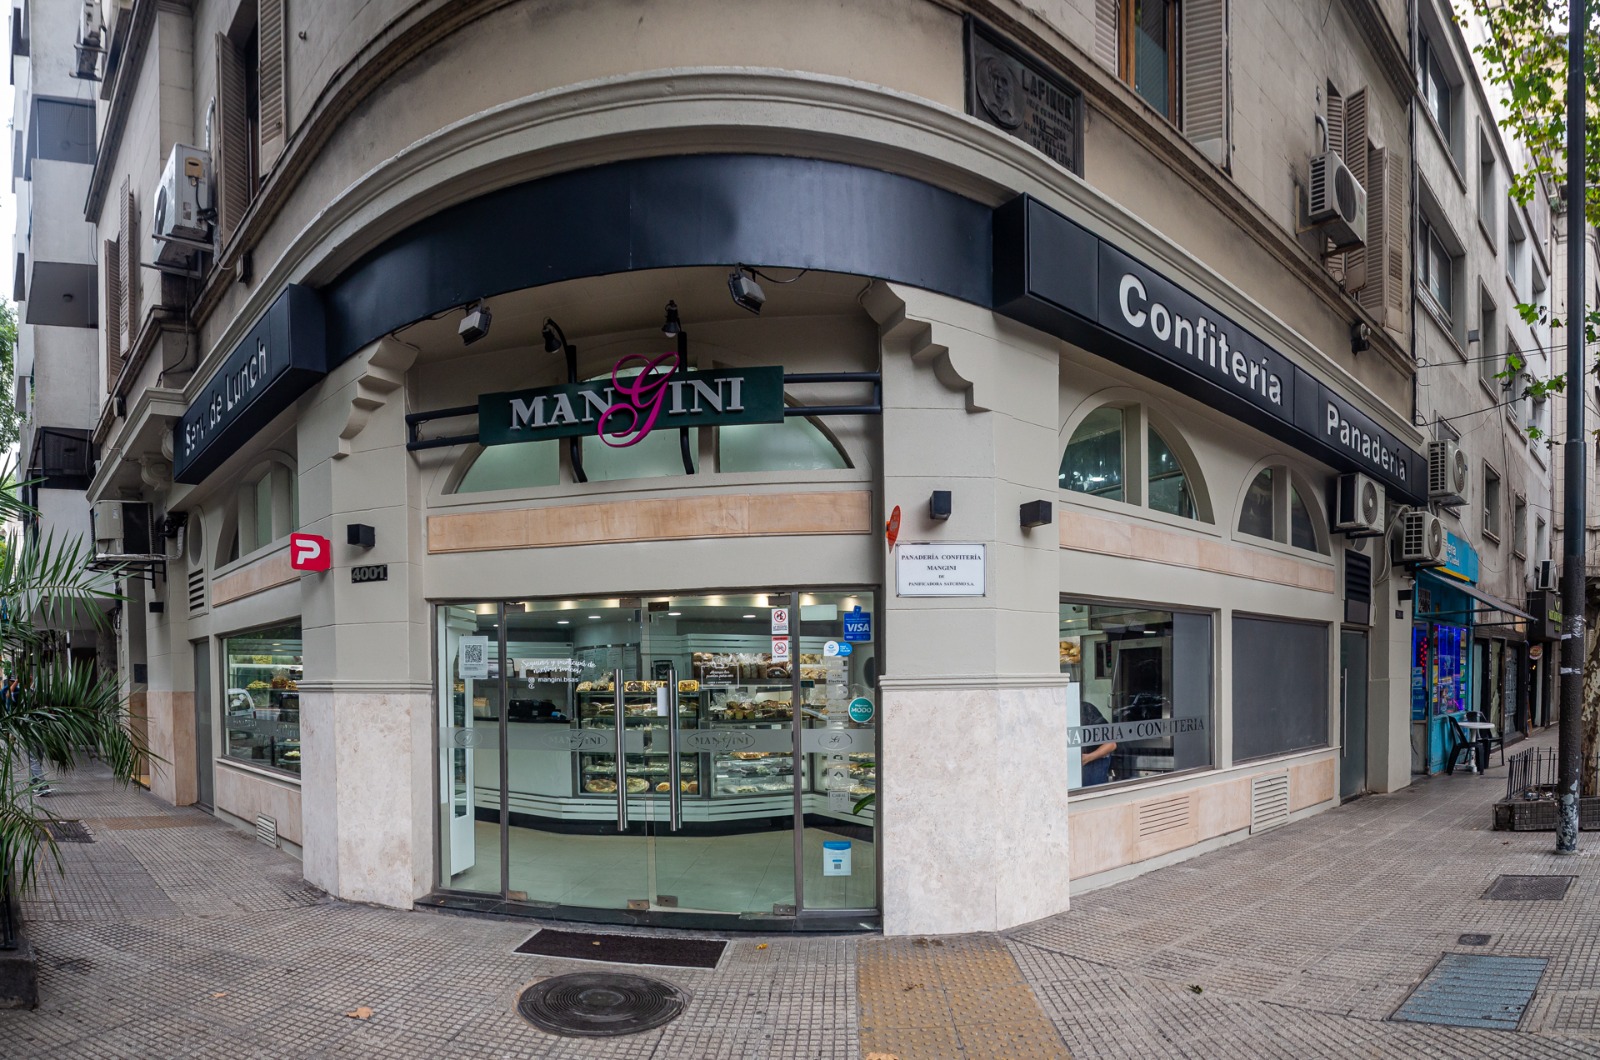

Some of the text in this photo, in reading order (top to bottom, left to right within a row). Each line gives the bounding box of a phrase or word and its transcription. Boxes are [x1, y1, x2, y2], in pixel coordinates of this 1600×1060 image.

[1119, 273, 1283, 406] Confitería
[186, 337, 267, 457] Serv. de Lunch
[509, 351, 745, 448] MANGINI
[1327, 401, 1407, 482] Panadería
[295, 539, 320, 565] P
[901, 553, 982, 561] PANADERÍA CONFITERÍA
[352, 566, 384, 581] 4001
[846, 623, 870, 632] VISA
[1136, 719, 1205, 737] CONFITERIA
